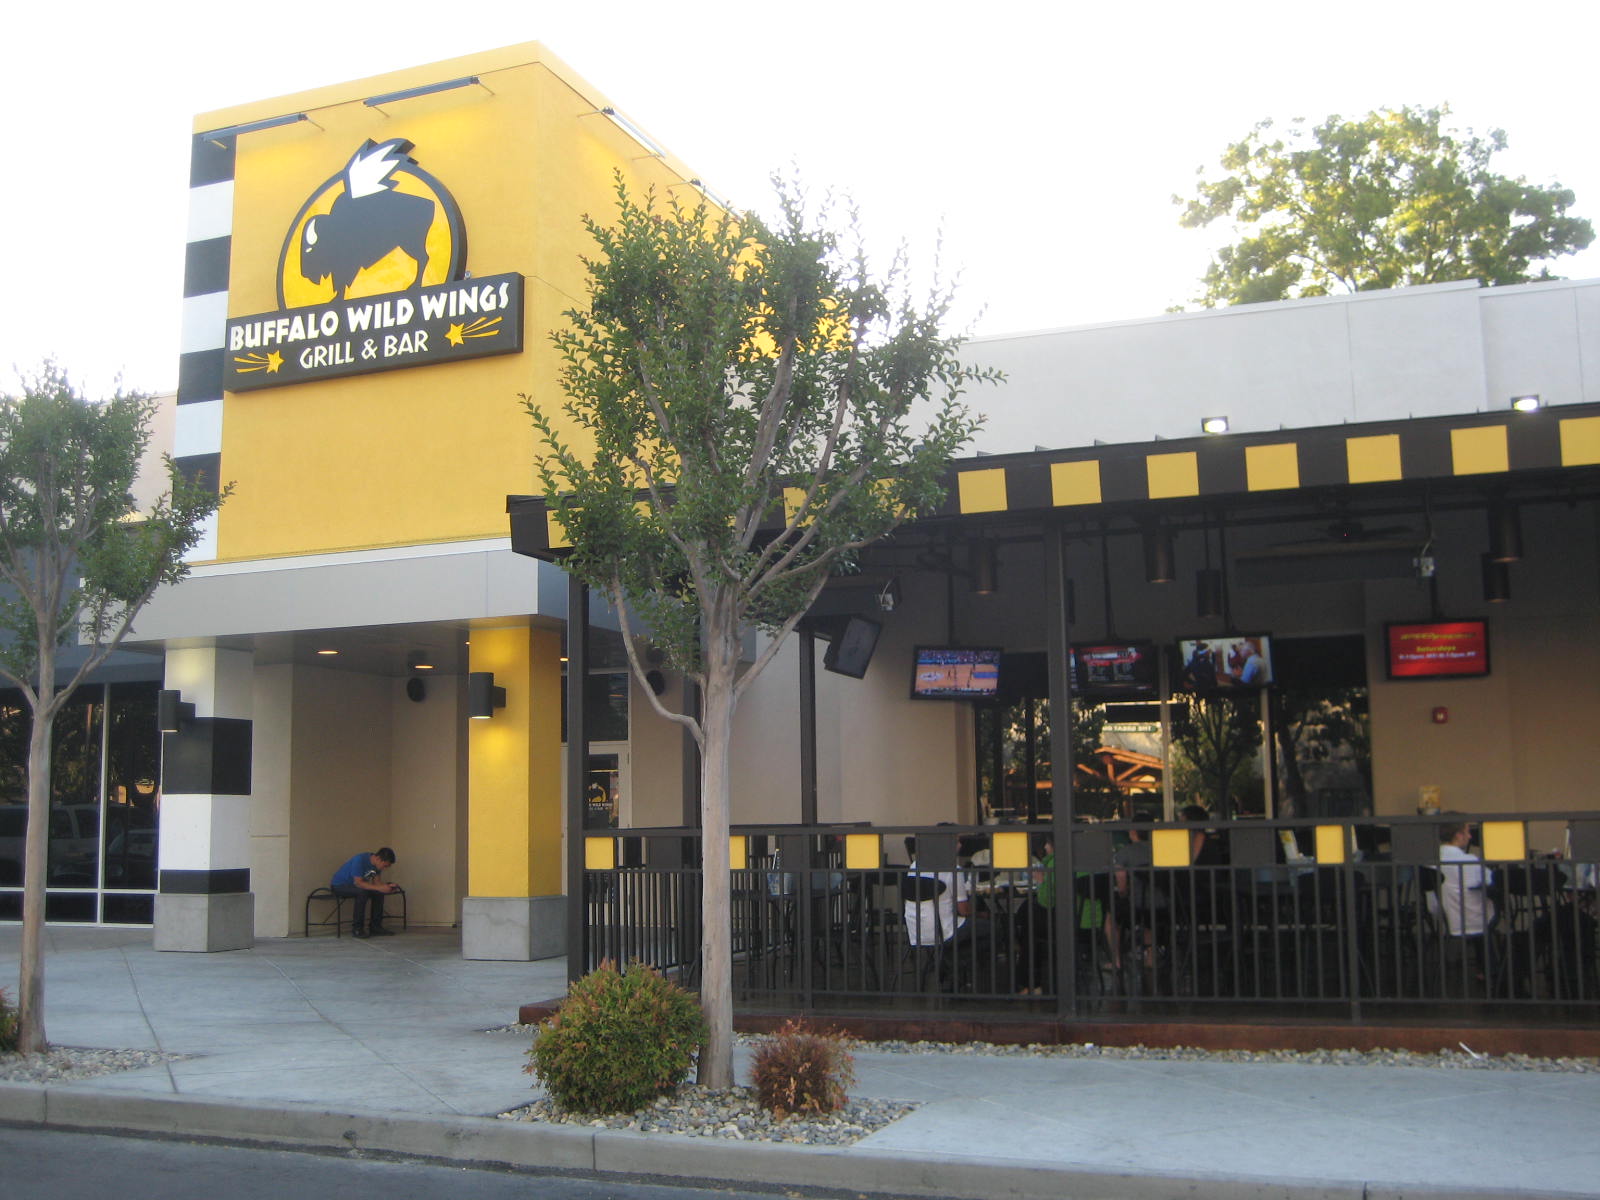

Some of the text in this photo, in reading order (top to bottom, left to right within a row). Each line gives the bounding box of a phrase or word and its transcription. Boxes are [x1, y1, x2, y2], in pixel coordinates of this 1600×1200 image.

[229, 281, 510, 352] BUFFALO WILD WINGS
[299, 330, 429, 369] GRILL & BAR
